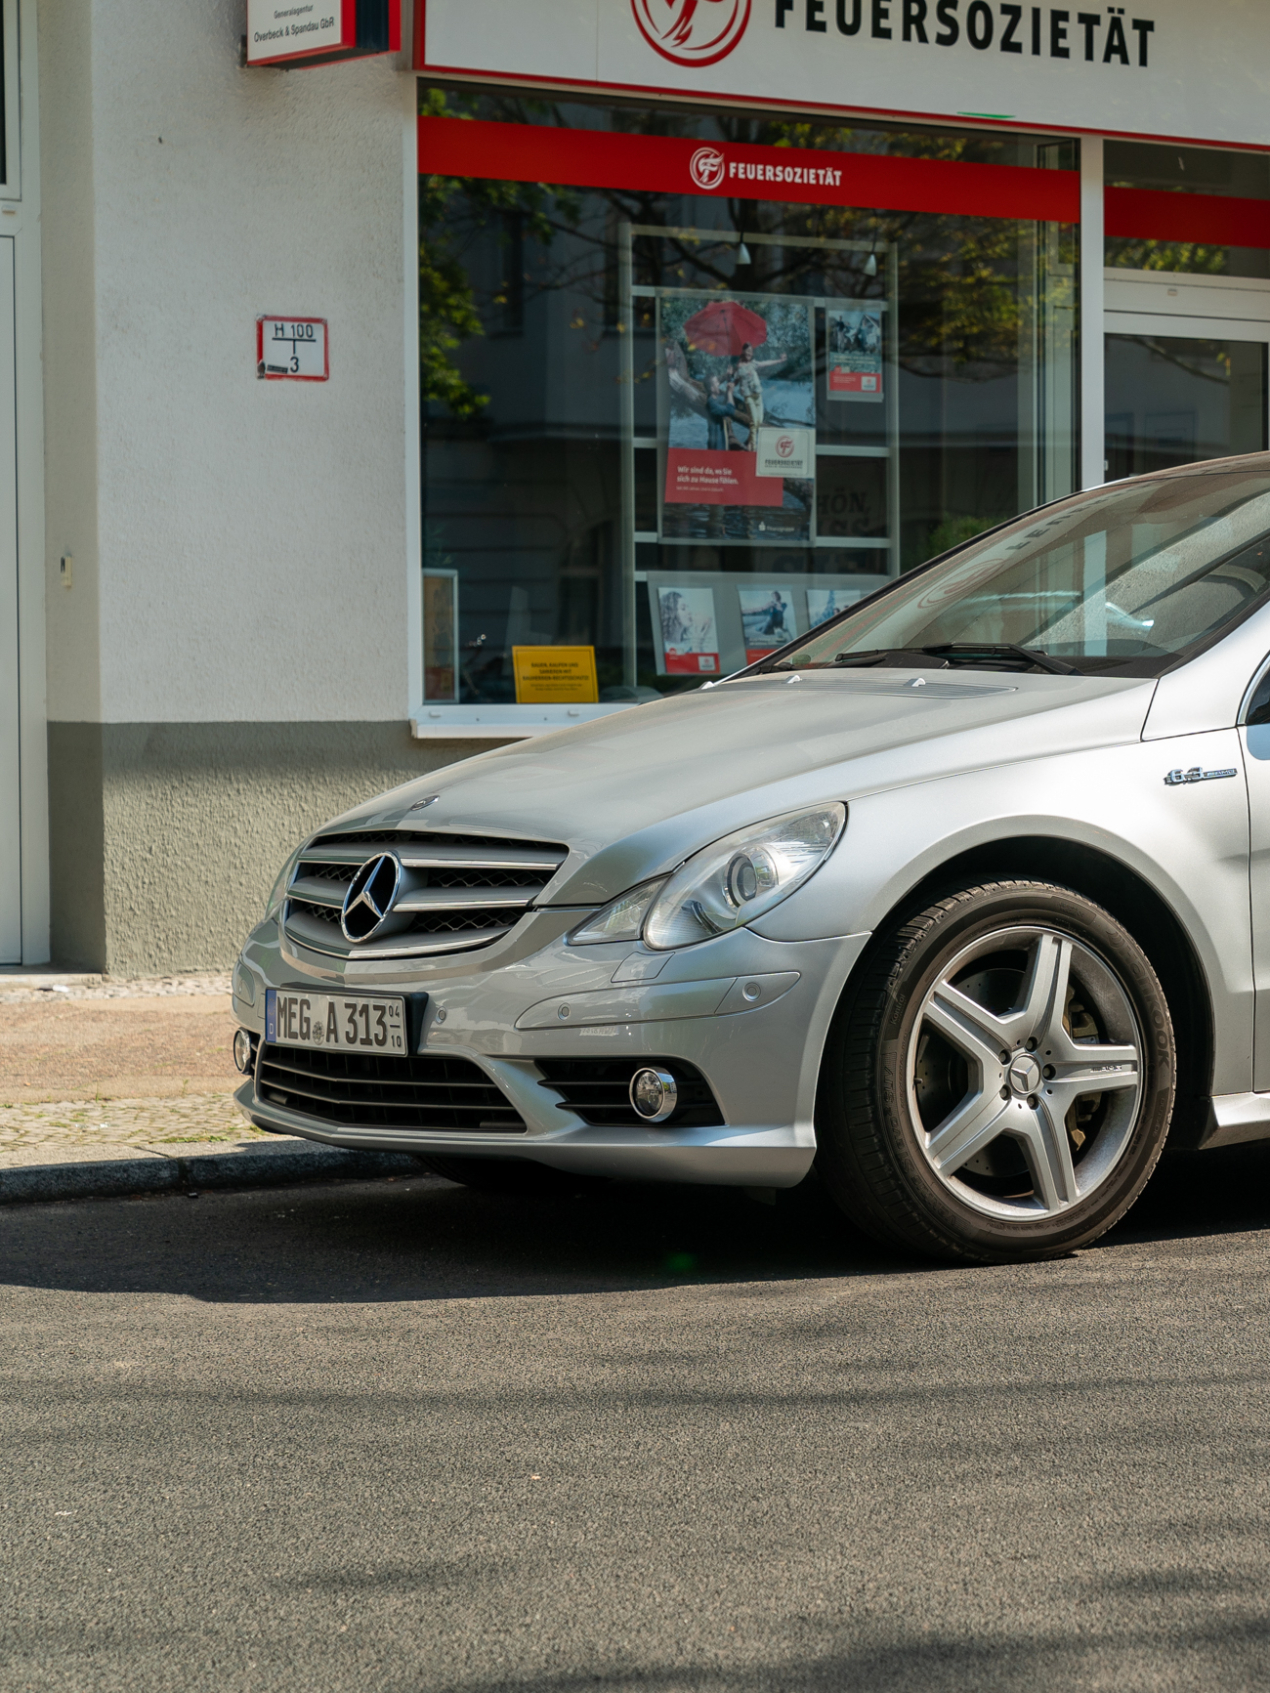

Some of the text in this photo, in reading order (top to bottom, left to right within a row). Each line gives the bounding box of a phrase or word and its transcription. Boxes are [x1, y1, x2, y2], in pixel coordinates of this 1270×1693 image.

[273, 4, 314, 19] Generalagentur
[253, 16, 335, 43] Overbeck & Spandau GbR
[774, 0, 1155, 67] FEUERSOZIETÄT
[729, 162, 842, 187] FEUERSOZIETÄT
[274, 323, 314, 339] H 100
[290, 355, 299, 373] 3
[388, 1005, 400, 1018] 04
[269, 996, 388, 1047] D MEG A 313
[391, 1034, 402, 1048] 10
